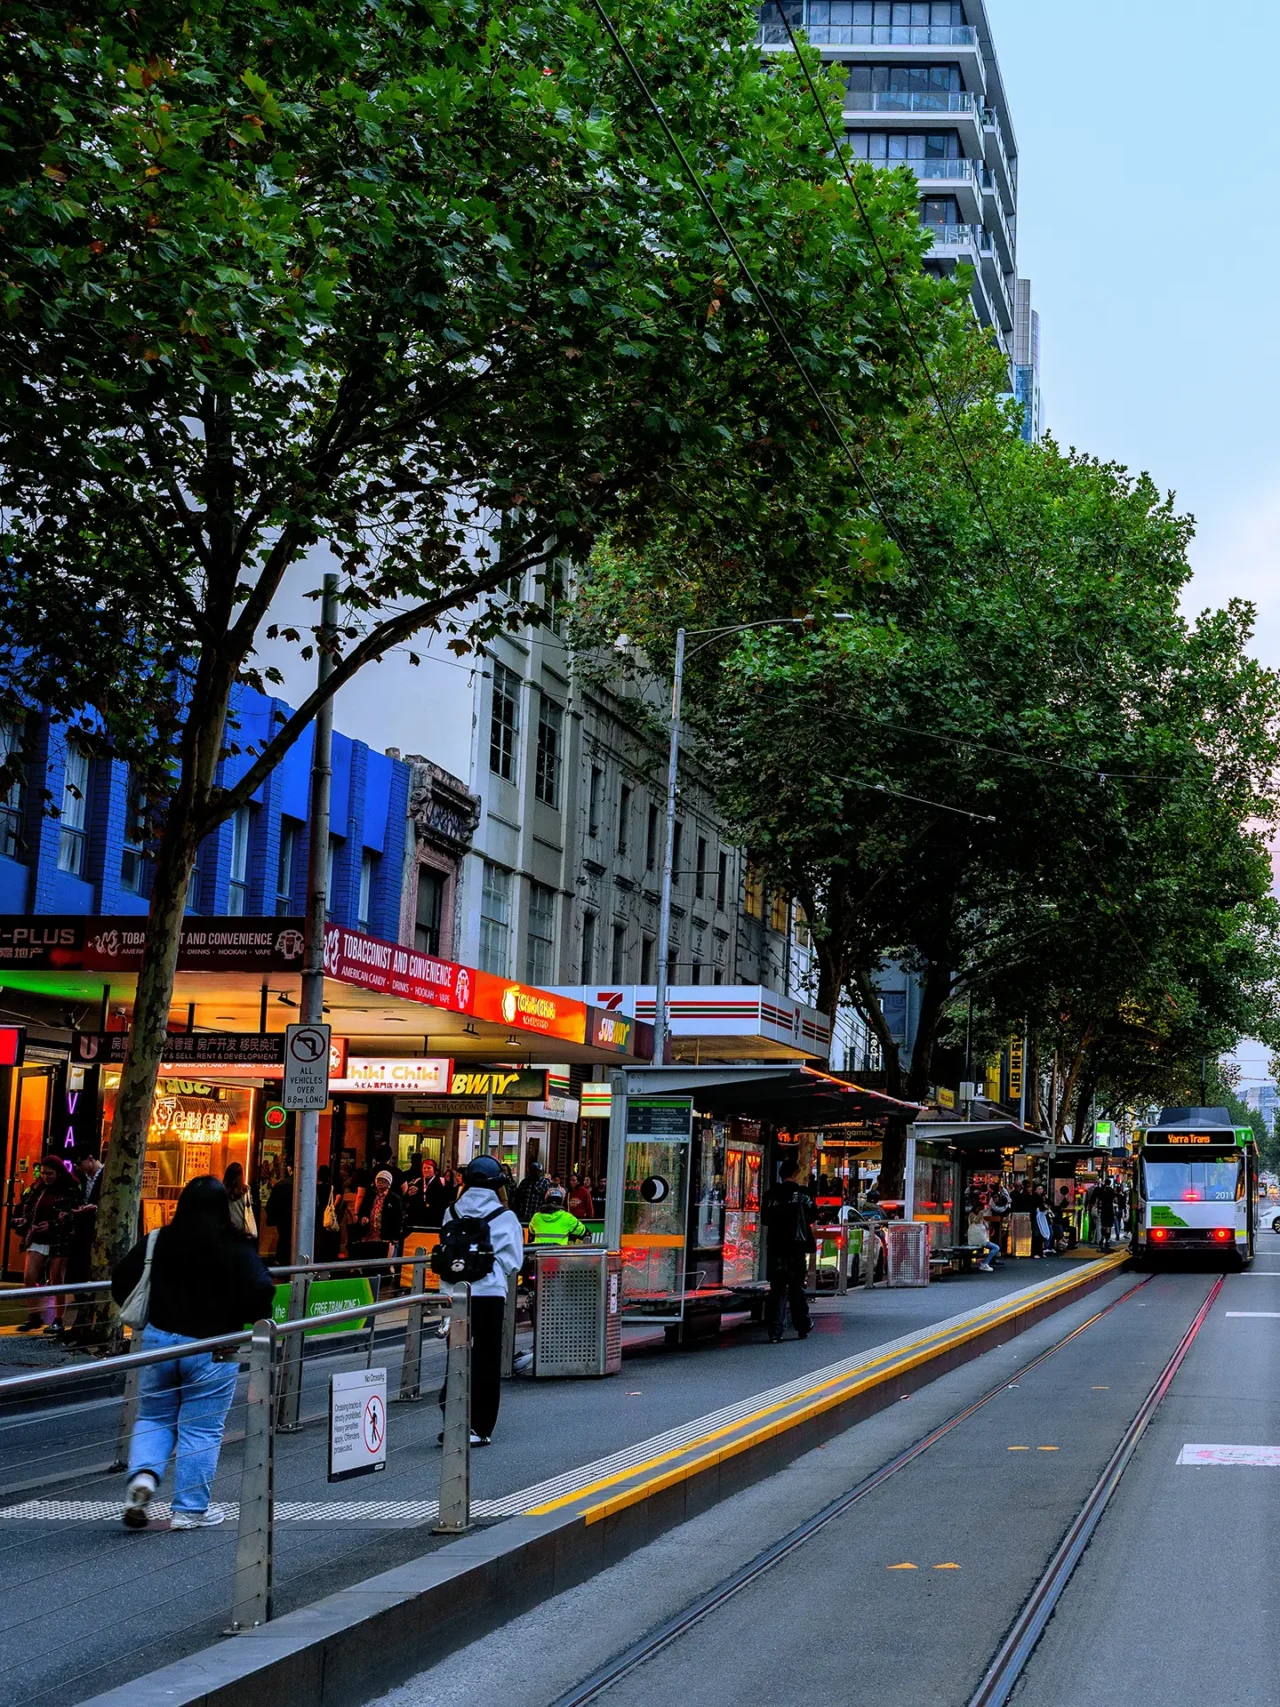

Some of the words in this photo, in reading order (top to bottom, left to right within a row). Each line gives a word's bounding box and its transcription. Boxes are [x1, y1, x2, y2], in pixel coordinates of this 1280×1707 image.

[0, 928, 75, 944] -PLUS
[186, 932, 206, 945] AND
[208, 932, 272, 945] CONVENIENCE
[343, 933, 392, 970] TOBACCONIST
[393, 950, 408, 975] AND
[409, 954, 453, 988] CONVENIENCE
[341, 965, 369, 982] AMERICAN
[369, 972, 386, 987] CANDY
[392, 979, 410, 993] DRINKS
[415, 986, 435, 1000] HOOKAH
[598, 1017, 630, 1046] SUBWAY
[300, 1067, 313, 1075] ALL
[391, 1065, 439, 1081] Chiki
[289, 1076, 323, 1085] VEHICLES
[452, 1073, 520, 1095] BWAY
[296, 1086, 315, 1094] OVER
[173, 1110, 202, 1130] Chiki
[202, 1111, 230, 1132] Chiki
[1168, 1134, 1189, 1144] Yarra
[1215, 1191, 1234, 1200] 2011
[275, 1303, 285, 1319] the
[314, 1301, 328, 1316] FREE
[328, 1299, 343, 1314] TRAM
[343, 1298, 357, 1310] ZONE
[365, 1374, 370, 1383] No
[371, 1373, 385, 1382] Crossing
[334, 1403, 349, 1413] Crossing
